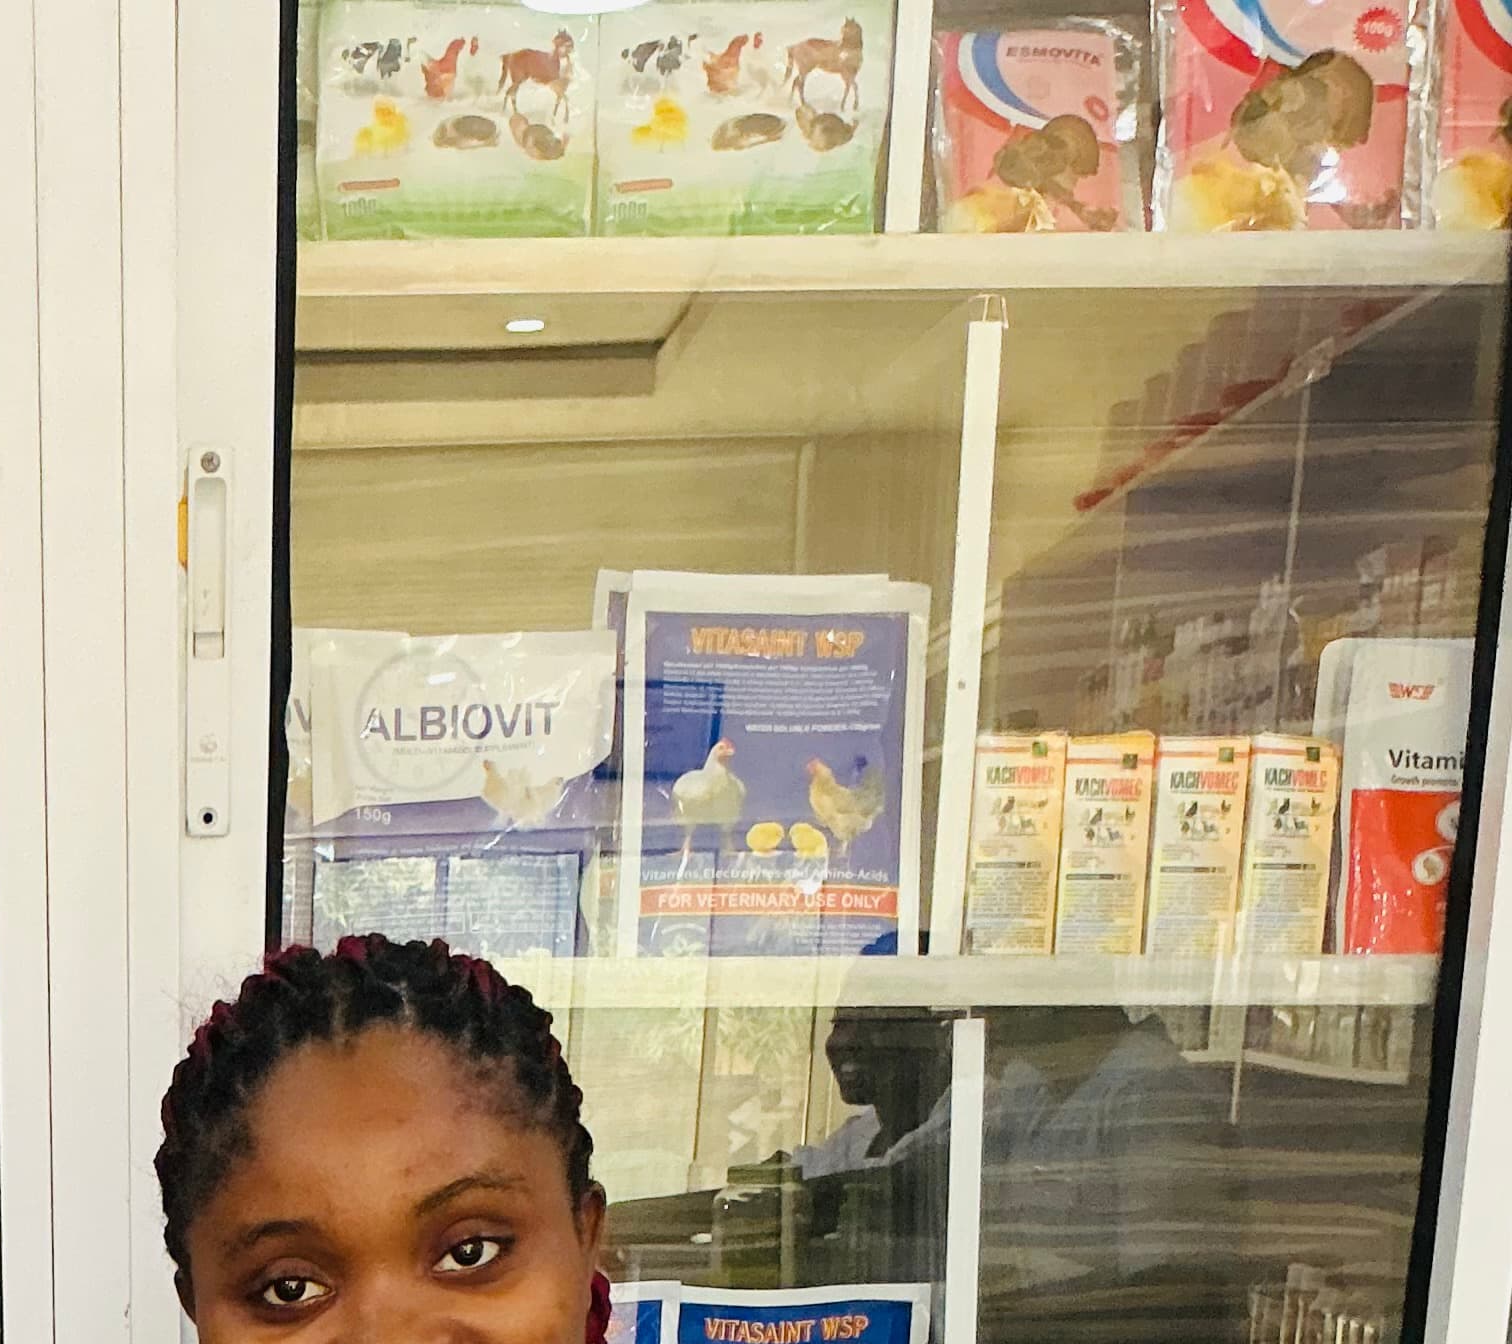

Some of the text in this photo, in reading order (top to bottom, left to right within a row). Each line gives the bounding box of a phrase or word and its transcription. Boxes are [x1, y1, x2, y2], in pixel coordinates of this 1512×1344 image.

[359, 701, 562, 741] ALBIOVIT
[355, 807, 392, 825] 150g
[658, 892, 882, 909] FOR VETERINARY USE ONLY
[704, 1315, 869, 1344] VITASAINT WSP
